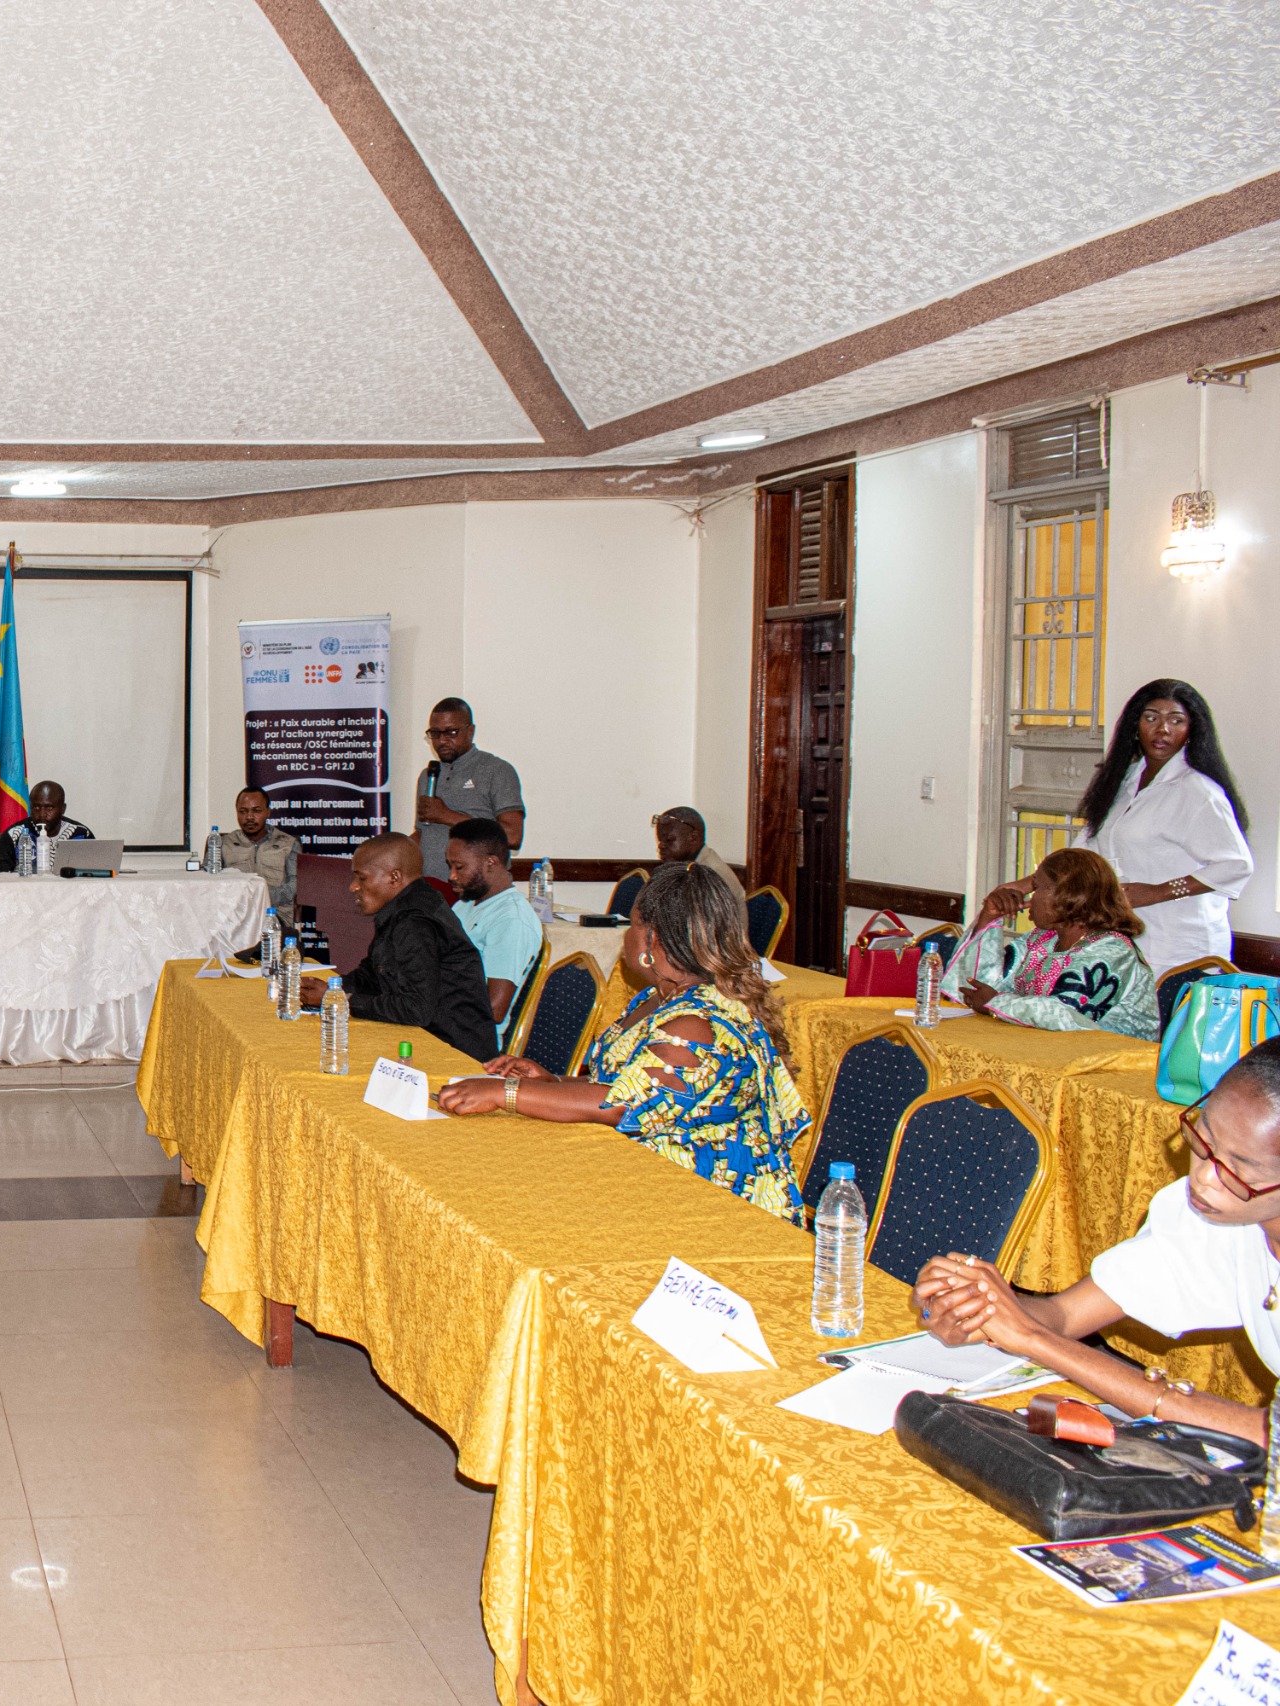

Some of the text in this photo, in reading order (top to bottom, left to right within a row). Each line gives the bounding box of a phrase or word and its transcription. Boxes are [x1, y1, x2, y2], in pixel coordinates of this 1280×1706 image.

[246, 720, 268, 729] Projet
[281, 719, 299, 727] Paix
[301, 718, 335, 727] durable
[281, 730, 314, 738] l'action
[316, 729, 363, 739] synergique
[267, 740, 302, 749] réseaux
[330, 739, 370, 748] féminines
[253, 751, 308, 760] mécanismes
[269, 800, 288, 809] ppui
[303, 800, 364, 808] renforcement
[324, 817, 351, 826] active
[353, 817, 368, 826] des
[370, 817, 387, 827] OSC
[300, 835, 311, 844] de
[313, 835, 348, 844] femmes
[664, 1267, 704, 1306] GENRE
